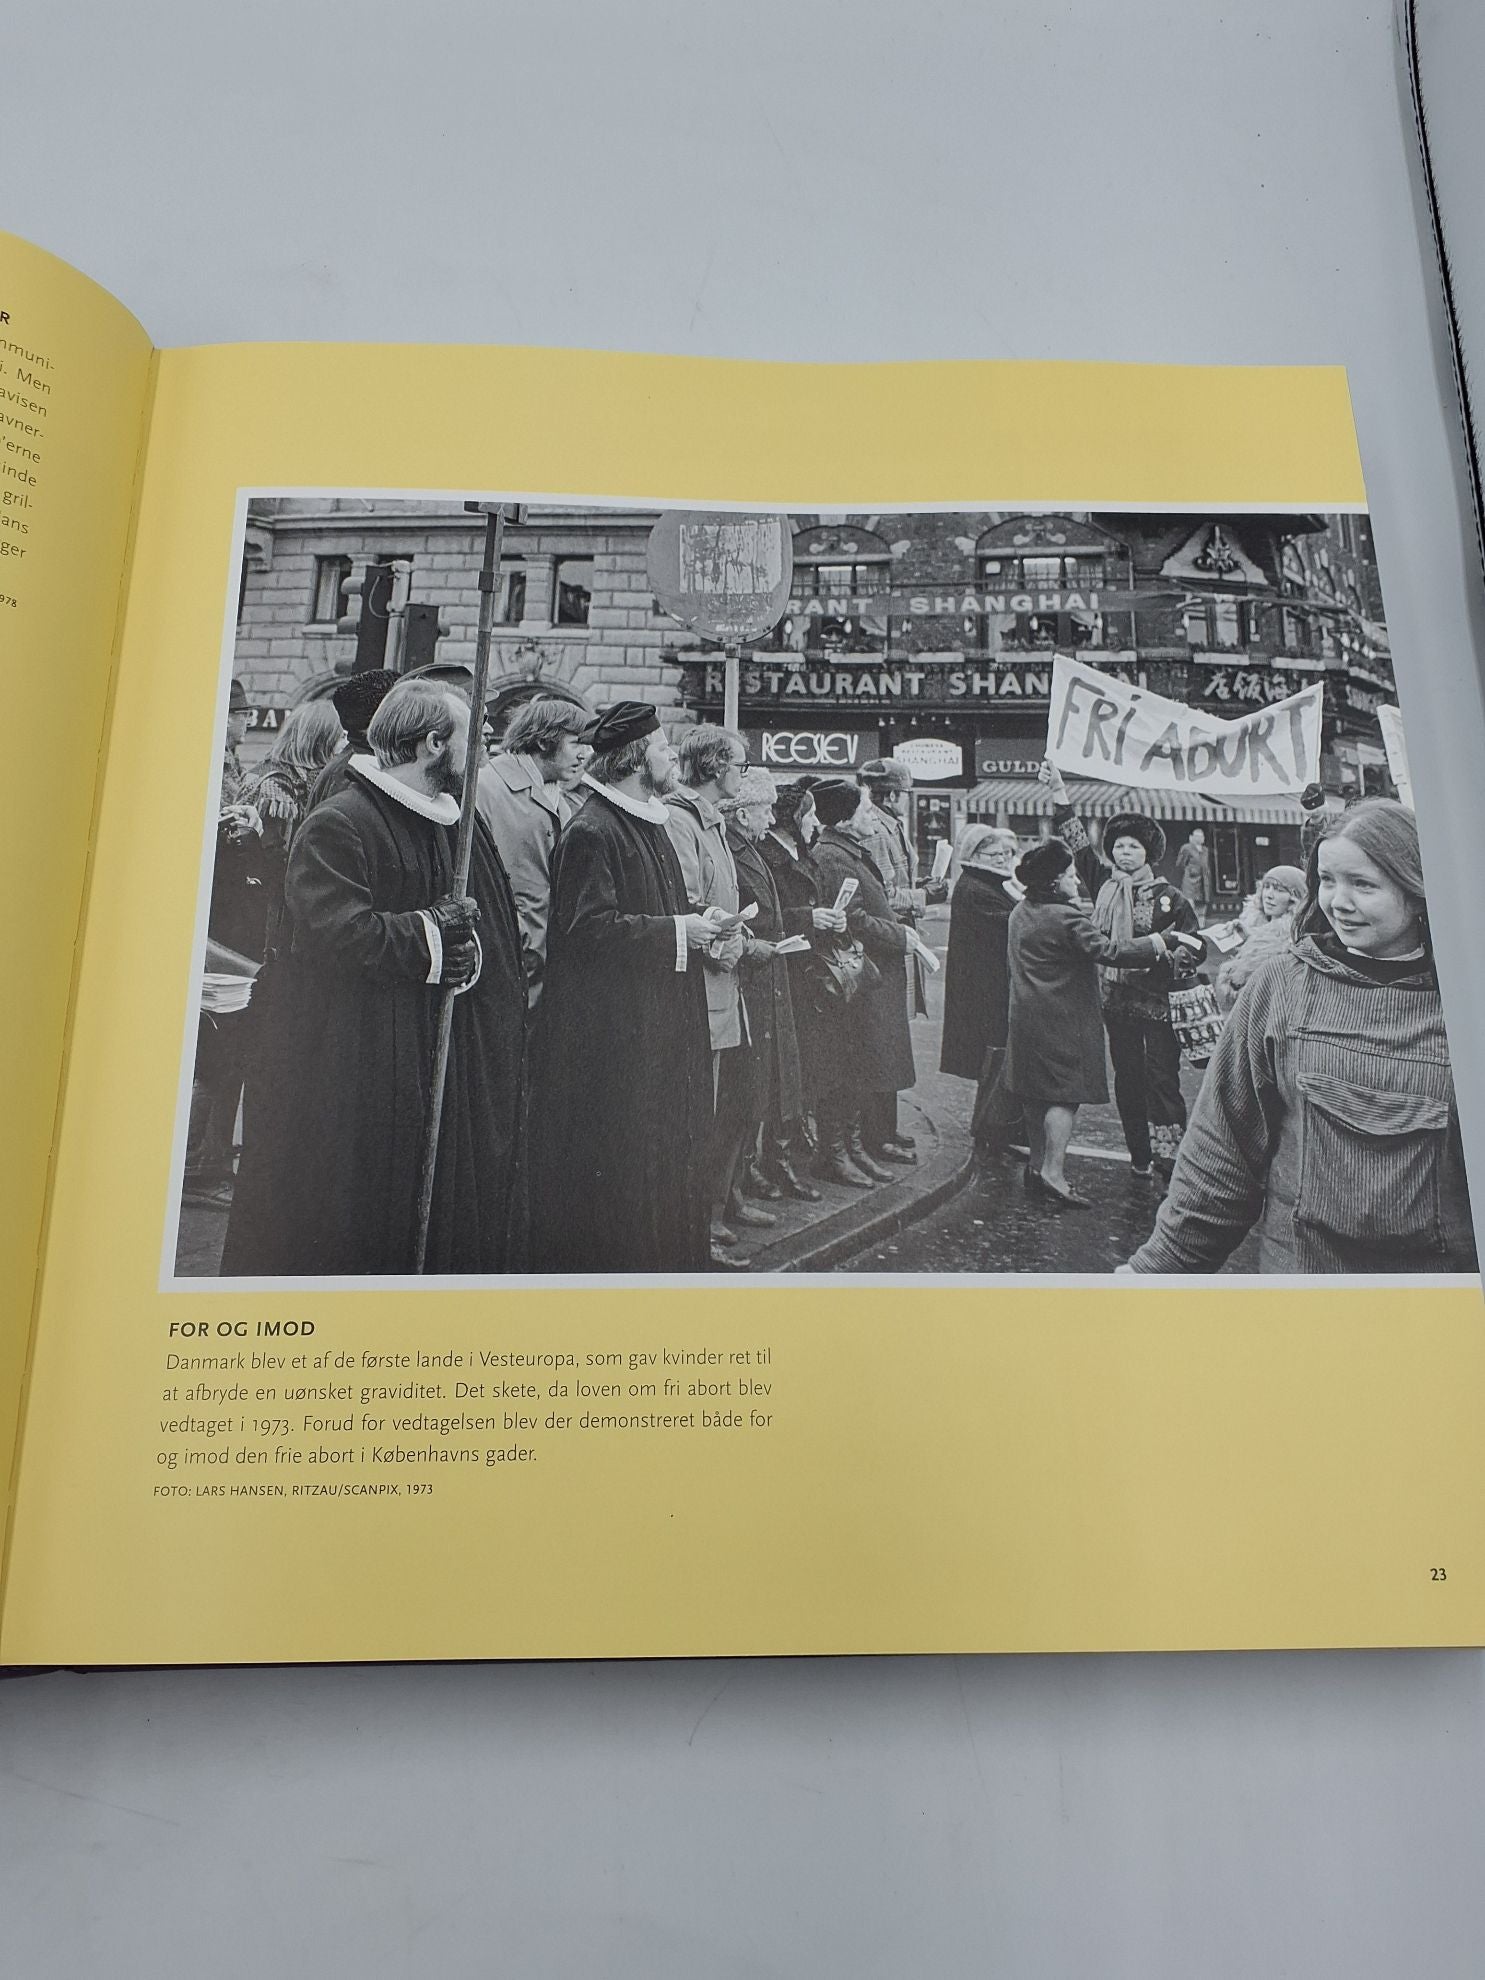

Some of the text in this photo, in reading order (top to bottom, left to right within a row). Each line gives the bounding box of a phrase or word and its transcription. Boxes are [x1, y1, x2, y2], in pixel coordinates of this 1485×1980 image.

[17, 368, 51, 395] Men
[0, 461, 37, 487] inde
[2, 491, 33, 509] gril-
[0, 511, 29, 534] ans
[787, 599, 872, 615] RANT
[909, 595, 1100, 614] SHANGHAI
[706, 670, 1147, 696] RSTAURANT SHANAI
[982, 760, 1040, 773] GULD
[168, 1320, 316, 1338] FOR OG IMOD
[166, 1346, 771, 1372] Danmark blev et af de første lande i Vesteuropa, som gav kvinder ret til
[162, 1377, 772, 1406] at afbryde en uønsket graviditet. Det skete, da loven om fri abort blev
[159, 1408, 773, 1438] vedtaget i 1973. Forud for vedtagelsen blev der demonstreret både for
[156, 1442, 537, 1470] og imod den frie abort i Københavns gader.
[153, 1483, 433, 1498] FOTO: LARS HANSEN, RITZAU/SCANPIX, 1973
[1430, 1568, 1447, 1581] 23
